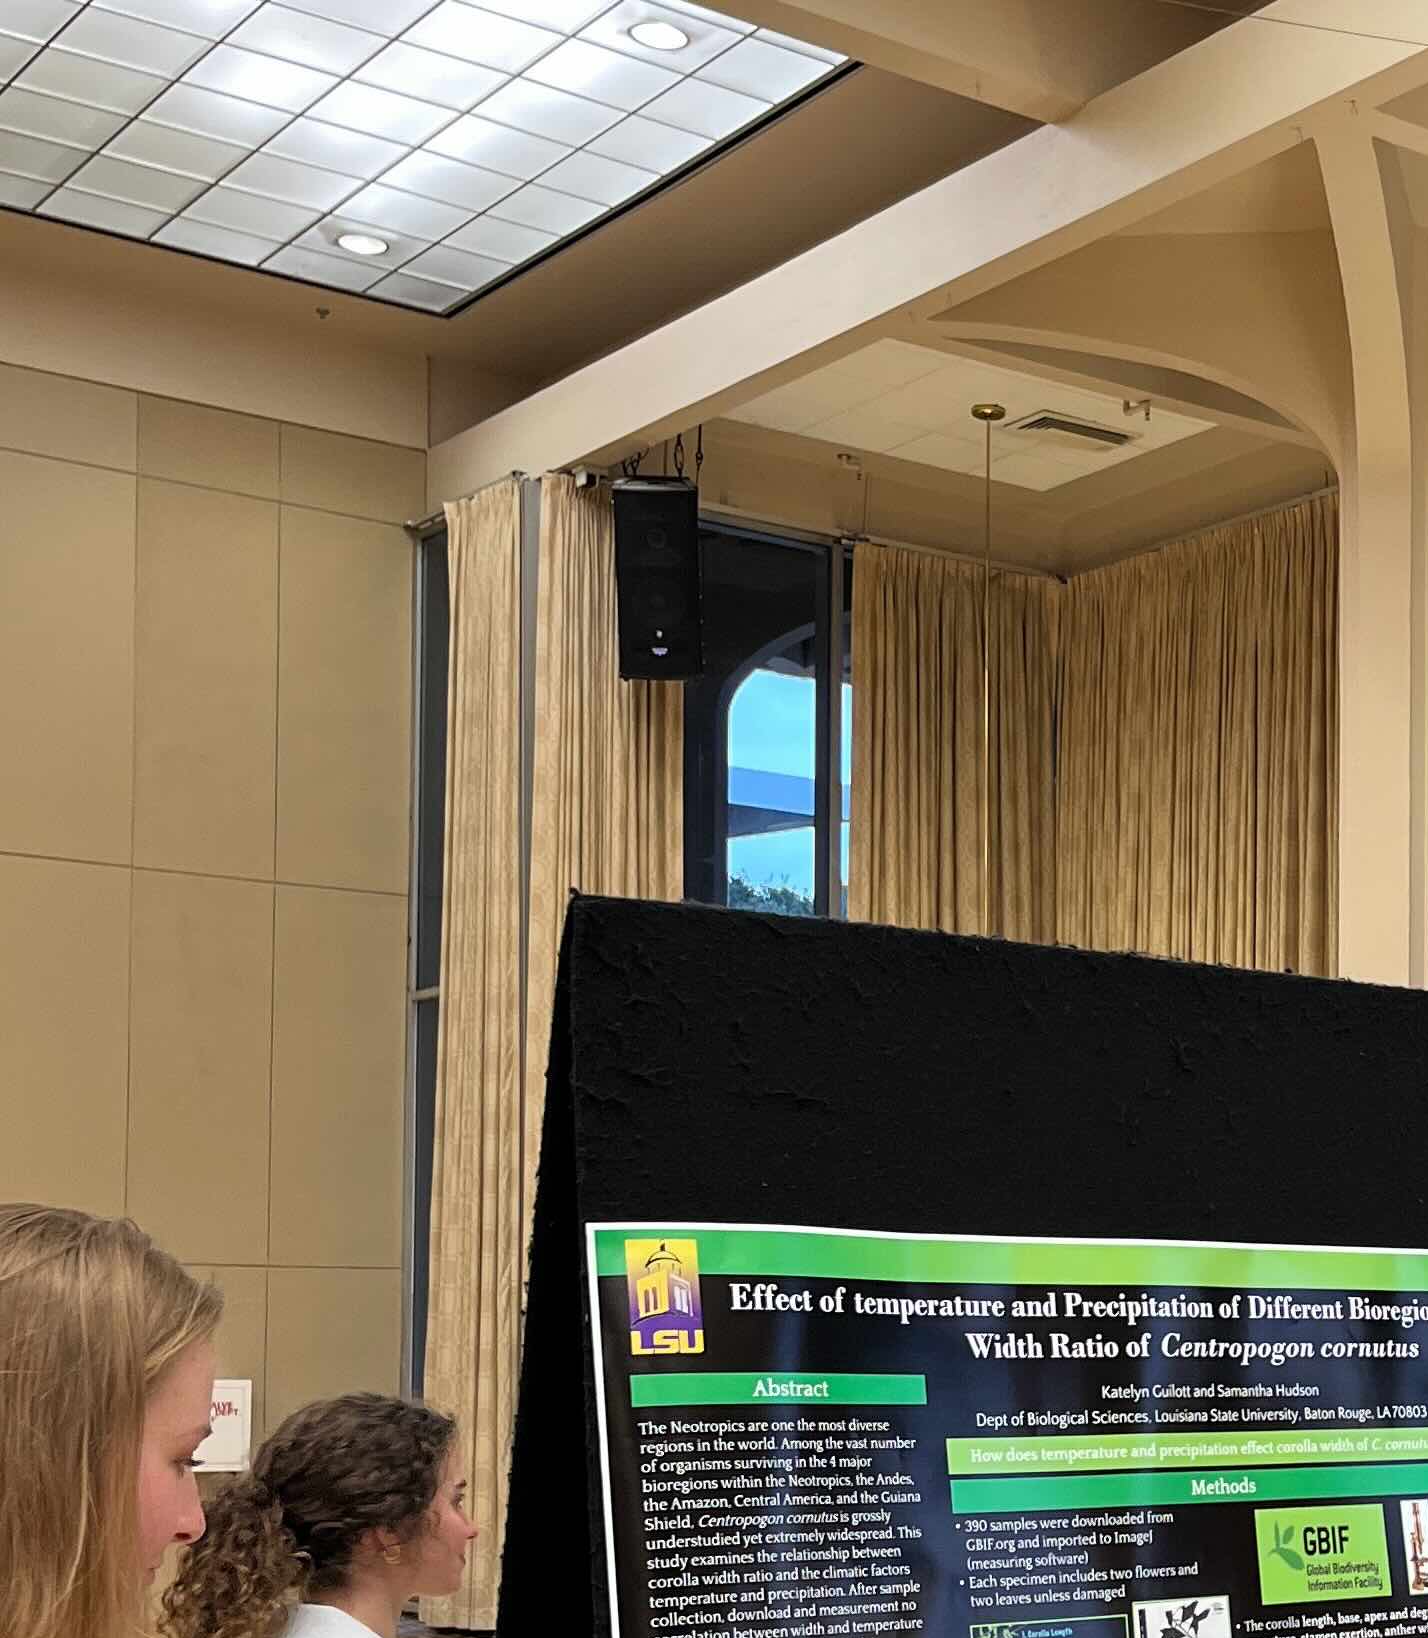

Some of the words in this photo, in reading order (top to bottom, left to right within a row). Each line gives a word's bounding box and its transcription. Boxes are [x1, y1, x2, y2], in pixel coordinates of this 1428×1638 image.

[728, 1283, 813, 1311] Effect
[819, 1286, 846, 1313] of
[853, 1293, 1005, 1323] temperature
[1011, 1292, 1058, 1317] and
[1063, 1292, 1214, 1325] Precipitation
[1218, 1294, 1241, 1318] of
[1247, 1295, 1344, 1319] Different
[630, 1329, 705, 1355] LSU
[964, 1333, 1044, 1358] Width
[1048, 1333, 1119, 1358] Ratio
[1125, 1332, 1151, 1357] of
[1161, 1333, 1315, 1365] Centropogon
[1320, 1340, 1419, 1357] cornutus
[752, 1377, 829, 1397] Abstract
[1101, 1384, 1150, 1402] Katelyn
[1193, 1383, 1215, 1398] and
[1216, 1383, 1273, 1397] Samantha
[1275, 1382, 1319, 1396] Hudson
[637, 1421, 667, 1435] The
[670, 1420, 746, 1436] Neotropics
[747, 1421, 769, 1432] are
[771, 1421, 795, 1431] one
[796, 1417, 816, 1431] the
[817, 1420, 846, 1431] most
[848, 1418, 890, 1431] diverse
[975, 1412, 1008, 1430] Dept
[1010, 1410, 1025, 1426] of
[1027, 1410, 1089, 1429] Biological
[1091, 1410, 1152, 1424] Sciences,
[1154, 1408, 1208, 1422] Louisiana
[1210, 1408, 1239, 1422] State
[1241, 1407, 1302, 1424] University,
[1303, 1406, 1335, 1420] Baton
[1337, 1406, 1374, 1422] Rouge,
[1391, 1405, 1427, 1418] 70803
[639, 1440, 695, 1457] regions
[696, 1438, 711, 1451] in
[713, 1437, 735, 1451] the
[780, 1437, 824, 1453] Among
[824, 1436, 844, 1449] the
[845, 1438, 868, 1449] vast
[870, 1436, 916, 1449] number
[970, 1449, 1003, 1462] How
[1005, 1447, 1039, 1461] does
[1040, 1447, 1128, 1464] temperature
[1130, 1442, 1157, 1457] and
[1159, 1443, 1239, 1460] precipitation
[1239, 1440, 1275, 1455] effect
[1275, 1438, 1318, 1453] corolla
[1318, 1438, 1355, 1452] width
[1355, 1437, 1368, 1451] of
[640, 1458, 658, 1473] of
[659, 1458, 732, 1475] organisms
[733, 1456, 793, 1471] surviving
[794, 1455, 806, 1468] in
[808, 1454, 828, 1468] the
[838, 1455, 872, 1470] major
[641, 1478, 719, 1494] bioregions
[720, 1474, 763, 1488] within
[765, 1473, 786, 1487] the
[788, 1474, 854, 1490] Neotropics,
[855, 1472, 875, 1486] the
[1191, 1476, 1256, 1495] Methods
[964, 1519, 987, 1532] 390
[989, 1517, 1038, 1534] samples
[1039, 1518, 1069, 1528] were
[1071, 1511, 1144, 1527] downloaded
[1146, 1510, 1174, 1523] from
[965, 1537, 1016, 1552] GBIF.org
[1017, 1534, 1040, 1548] and
[1042, 1531, 1097, 1550] imported
[1099, 1533, 1112, 1544] to
[1303, 1525, 1349, 1556] GBIF
[967, 1556, 1033, 1570] (measuring
[1034, 1551, 1088, 1566] software)
[1306, 1563, 1331, 1576] Global
[1332, 1560, 1379, 1575] Biodiversity
[968, 1574, 997, 1589] Each
[999, 1573, 1056, 1590] specimen
[1058, 1568, 1108, 1583] includes
[1109, 1568, 1133, 1580] two
[1134, 1564, 1176, 1578] flowers
[1177, 1561, 1198, 1576] and
[1307, 1578, 1353, 1591] Information
[1353, 1575, 1383, 1590] Facility
